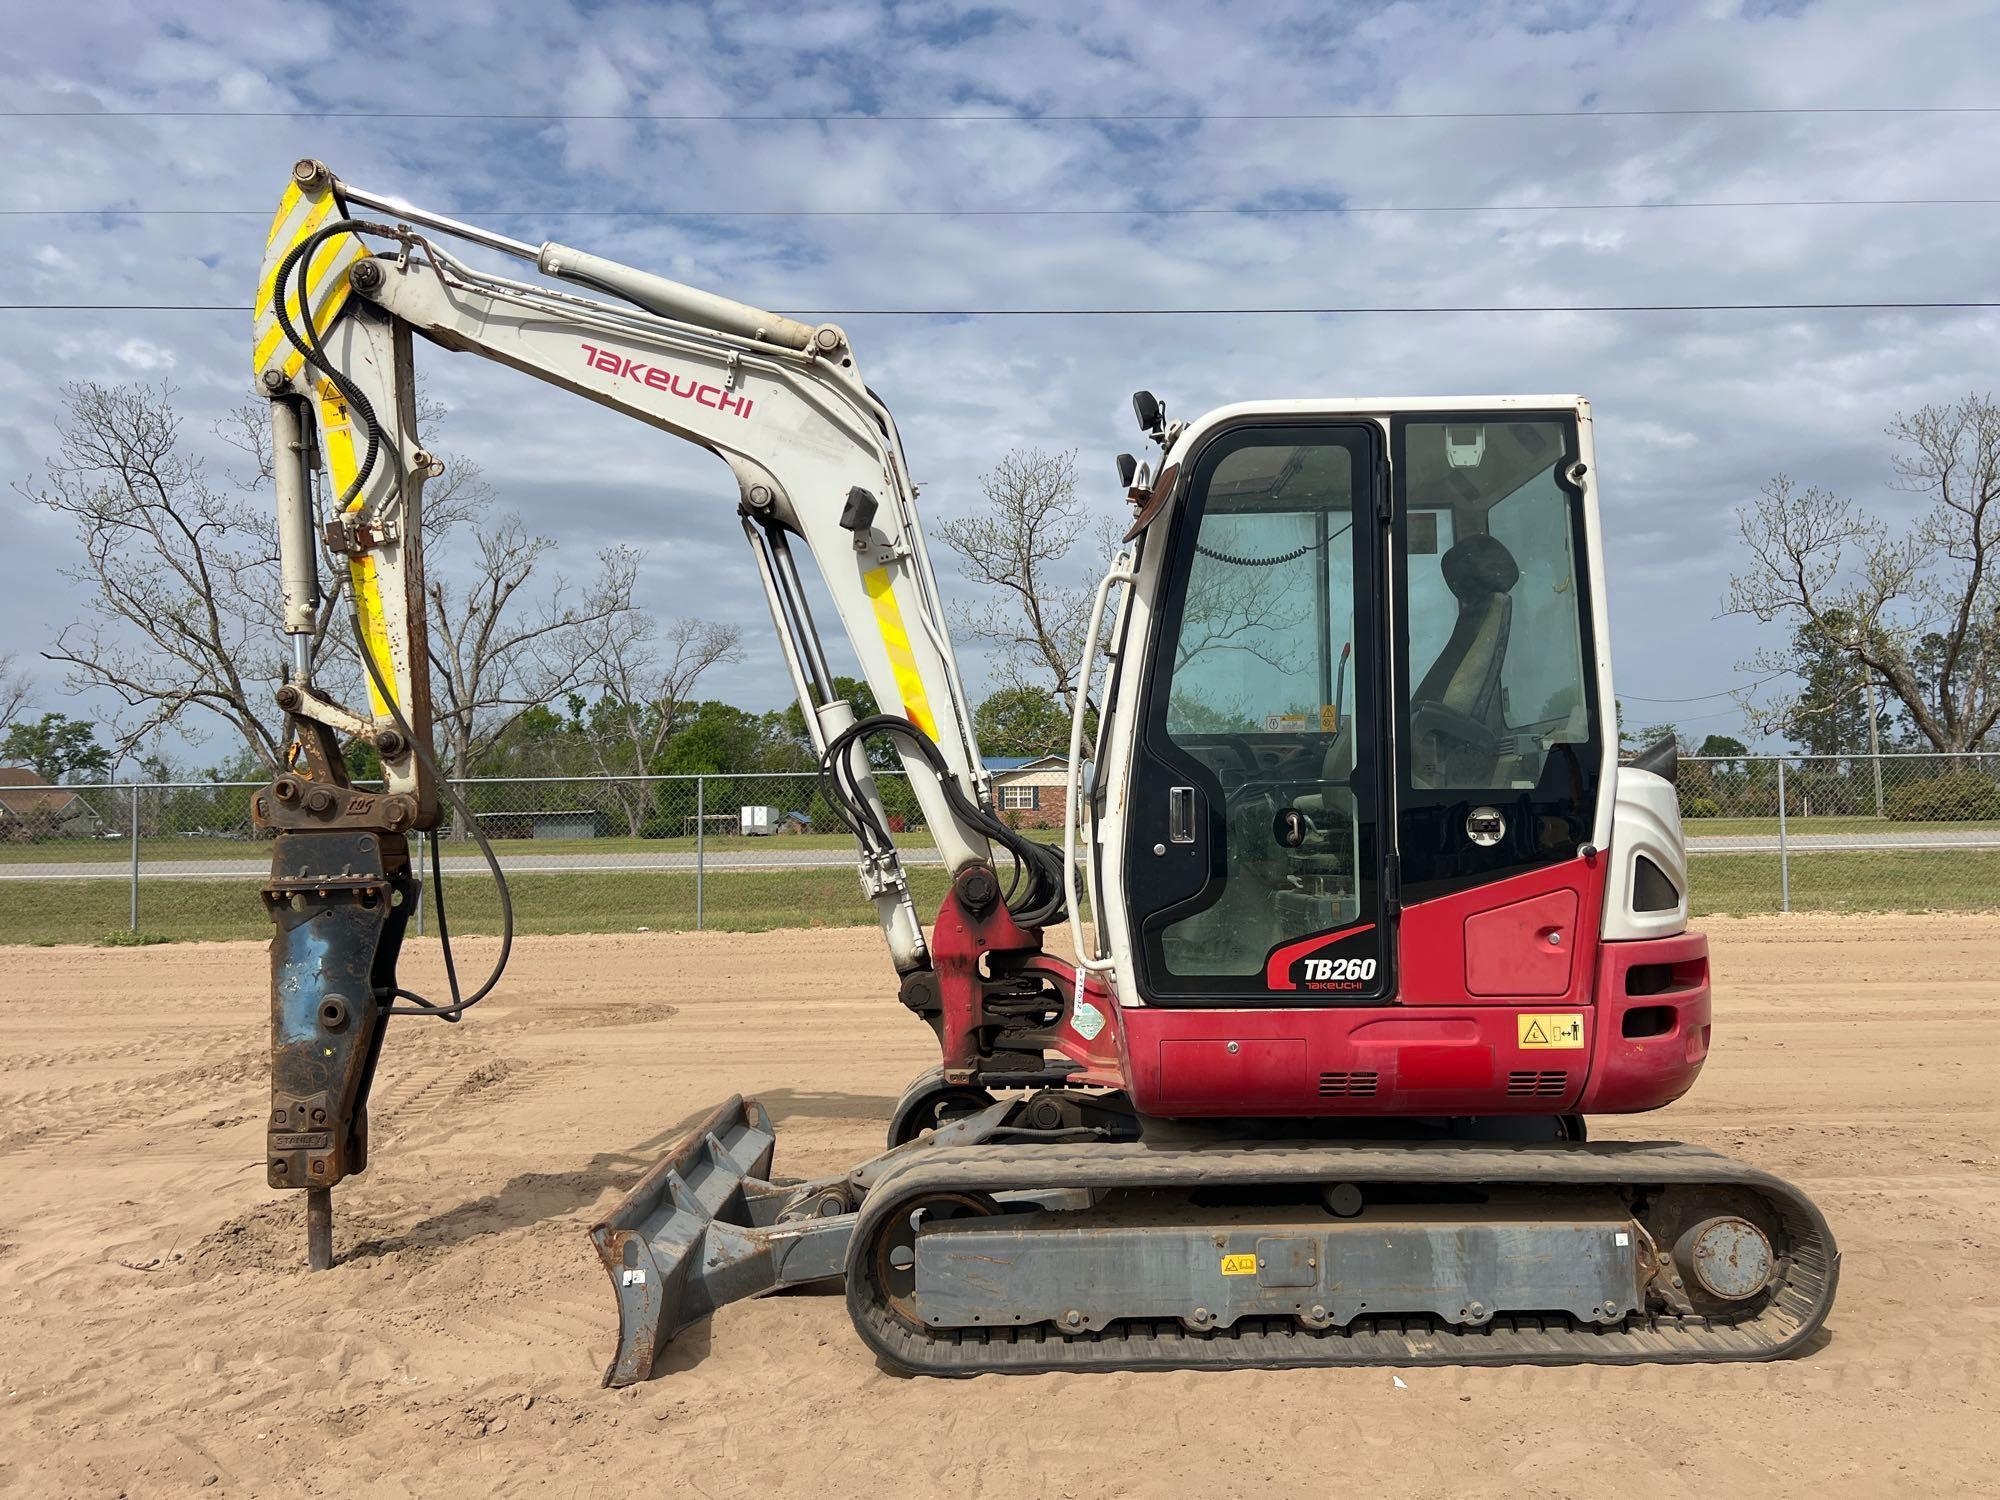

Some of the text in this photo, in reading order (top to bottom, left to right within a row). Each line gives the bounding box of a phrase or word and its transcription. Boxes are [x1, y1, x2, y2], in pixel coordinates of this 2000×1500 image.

[581, 344, 754, 419] TAKEUCHI
[1304, 958, 1377, 980] TB260
[1305, 982, 1363, 990] TAKEUCHI
[276, 1134, 326, 1145] STANLEY
